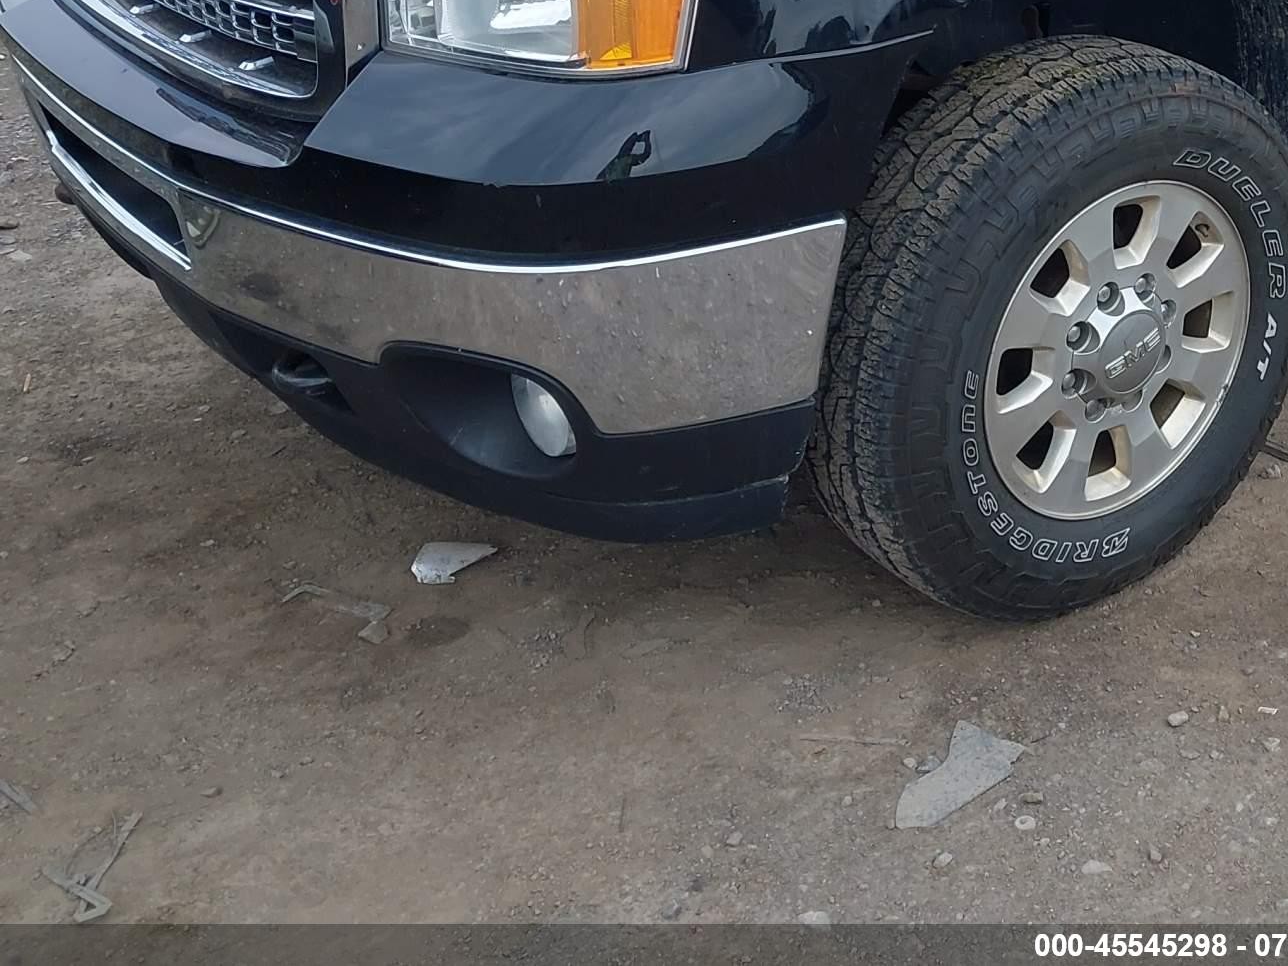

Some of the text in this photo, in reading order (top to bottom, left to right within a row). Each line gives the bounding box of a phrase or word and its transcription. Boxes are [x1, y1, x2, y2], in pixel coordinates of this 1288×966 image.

[1105, 327, 1161, 379] GMC
[1173, 148, 1287, 381] DUELER A/T
[961, 369, 1131, 563] BRIDGESTONE
